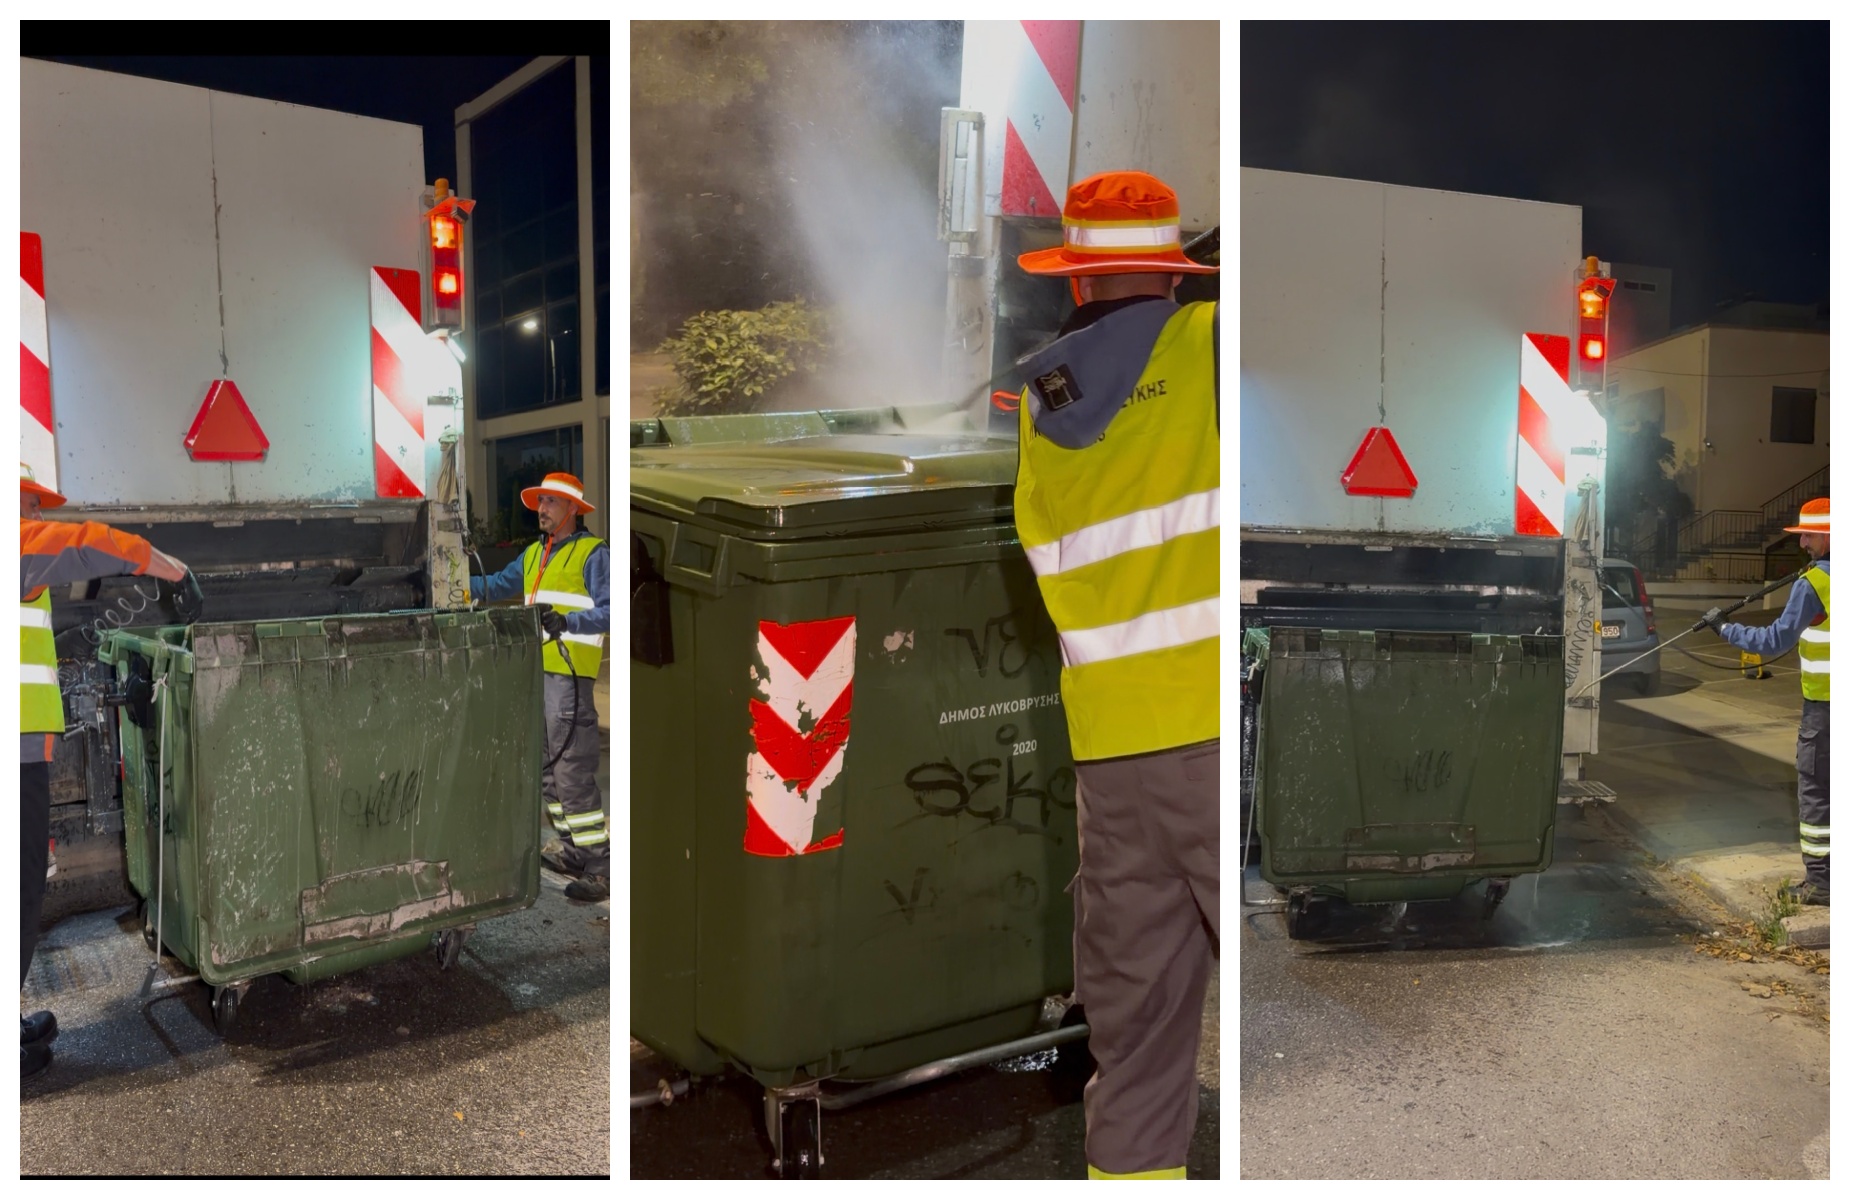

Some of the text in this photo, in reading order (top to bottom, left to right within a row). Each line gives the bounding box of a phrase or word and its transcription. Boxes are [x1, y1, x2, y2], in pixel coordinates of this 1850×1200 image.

[1121, 379, 1167, 408] ΥΚΗΣ
[939, 693, 1060, 724] ΔΗΜΟΣ ΛΥΚΟΒΡΥΣΗΣ
[1012, 739, 1037, 756] 2020
